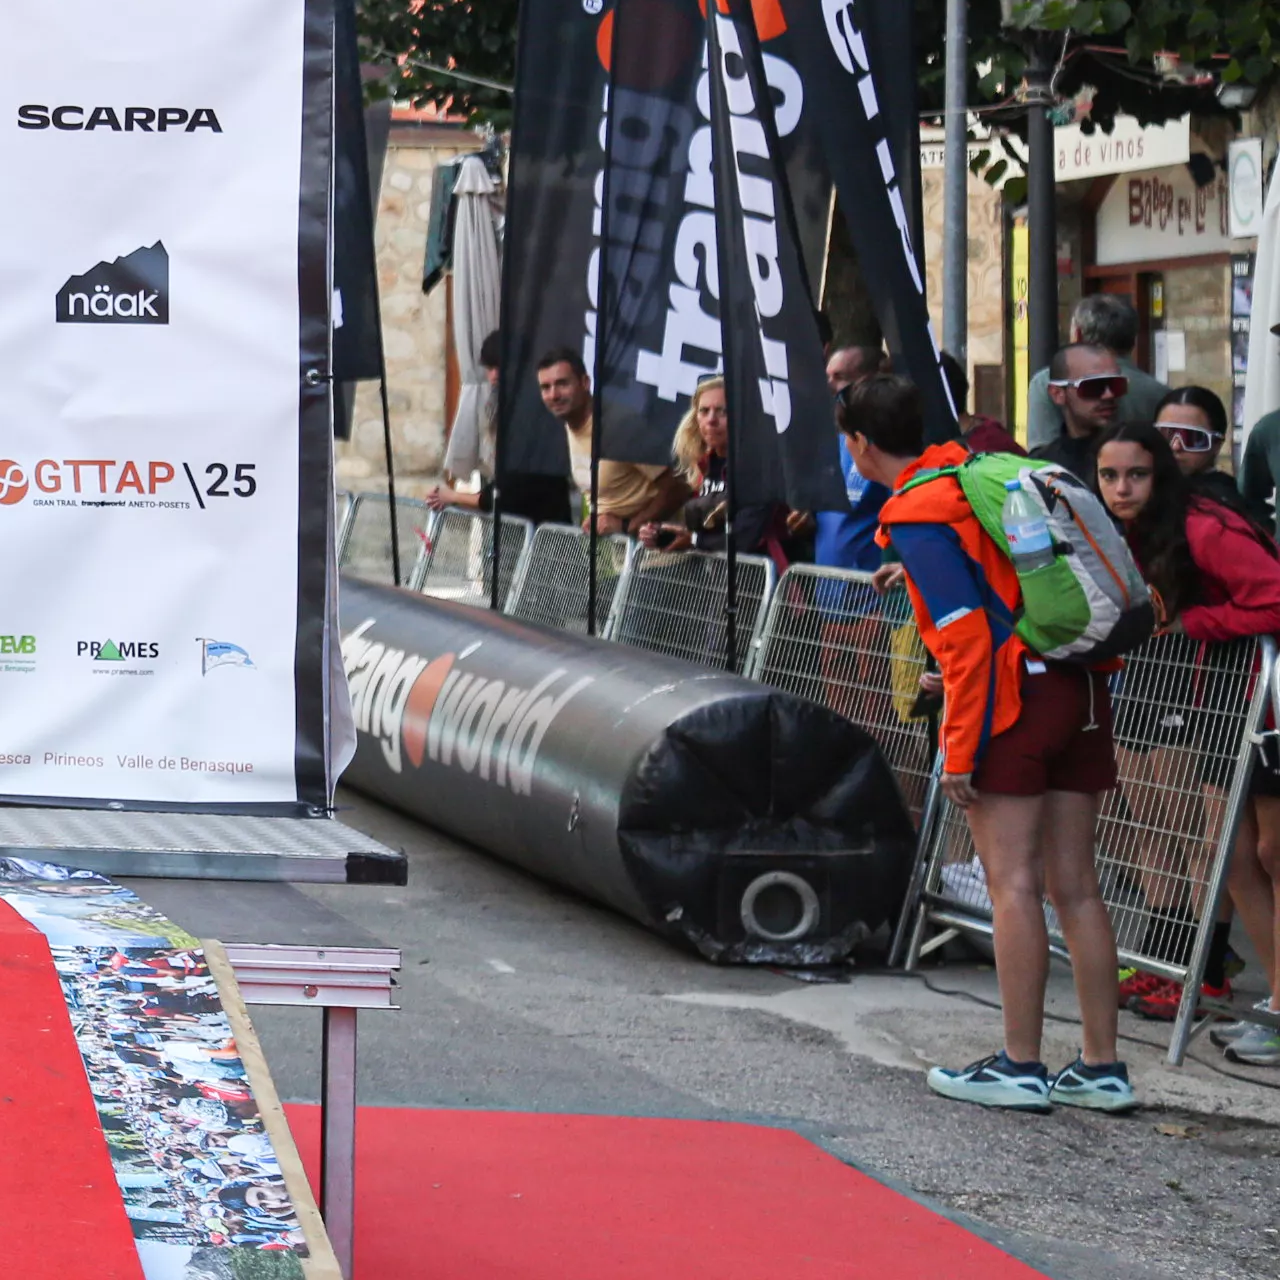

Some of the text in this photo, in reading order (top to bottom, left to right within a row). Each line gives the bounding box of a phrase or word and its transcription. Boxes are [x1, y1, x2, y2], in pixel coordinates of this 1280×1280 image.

[17, 104, 224, 133] SCARPA
[1075, 141, 1091, 166] de
[1101, 137, 1144, 162] vinos
[68, 284, 158, 317] näak
[34, 459, 175, 494] GTTAP
[128, 501, 190, 509] ANETO-POSETS
[92, 668, 154, 677] www.prames.com
[43, 752, 104, 768] Pirineos
[117, 755, 153, 769] Valle
[158, 756, 176, 770] de
[180, 757, 254, 775] Benasque
